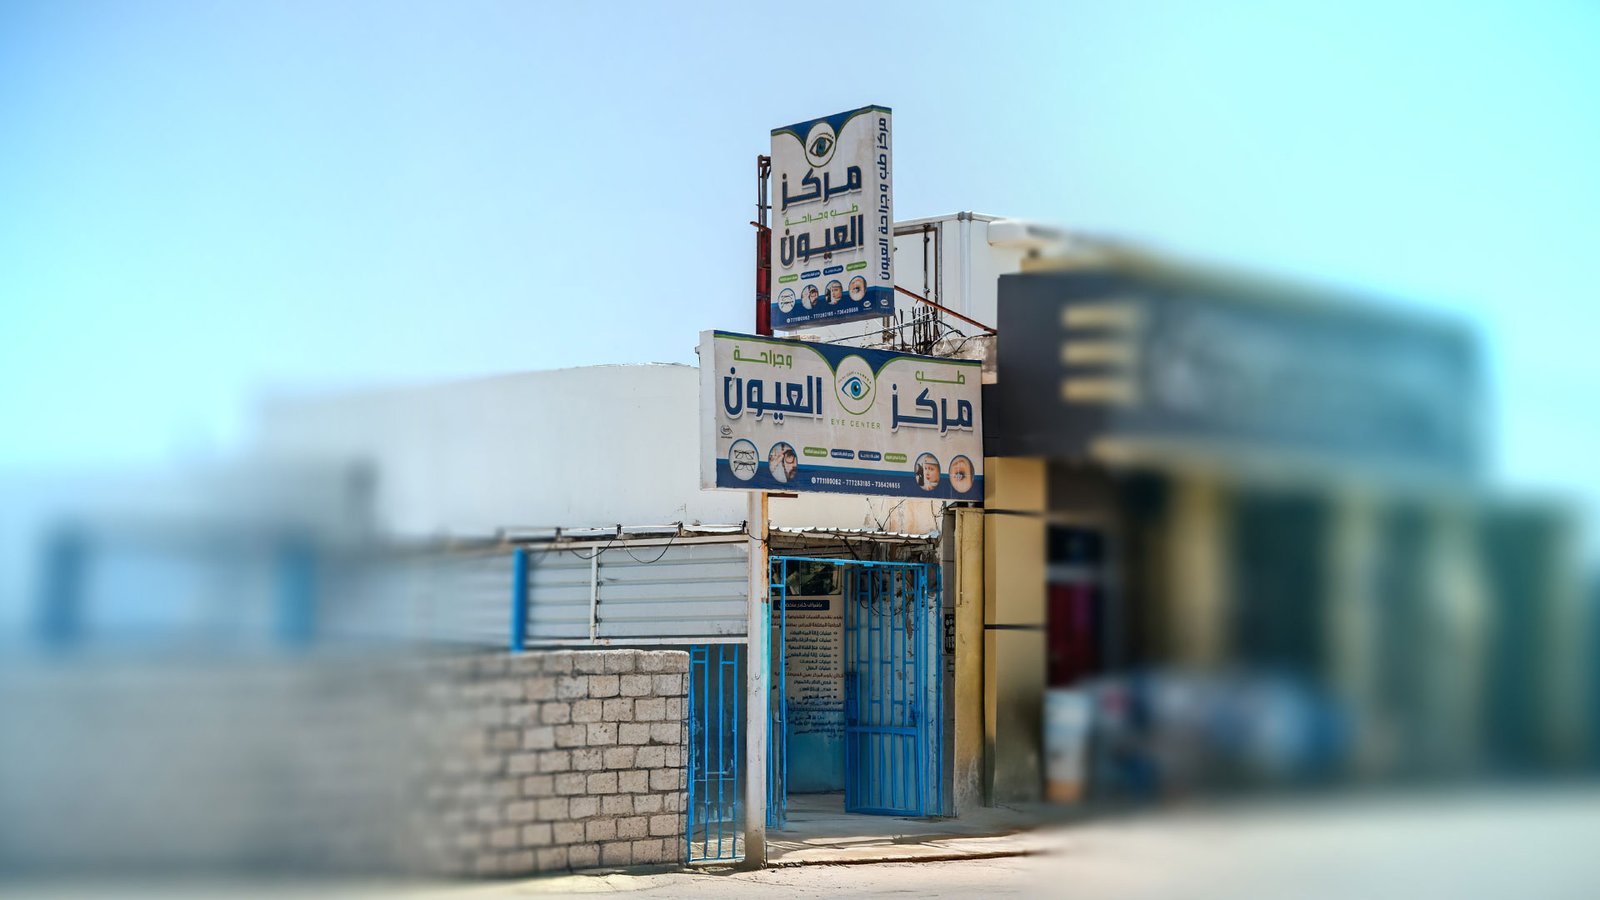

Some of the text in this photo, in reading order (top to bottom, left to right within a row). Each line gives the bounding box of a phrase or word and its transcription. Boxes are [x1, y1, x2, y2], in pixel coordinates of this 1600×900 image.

[876, 117, 889, 151] مركز
[877, 153, 889, 181] طب
[781, 165, 862, 213] مركز
[830, 203, 858, 217] طب
[780, 214, 864, 267] العيون
[878, 237, 891, 281] العيون
[733, 346, 792, 369] وجراحة
[723, 367, 823, 421] العيون
[915, 370, 966, 385] طب
[830, 418, 881, 430] EYE CENTER
[892, 383, 973, 433] مركز
